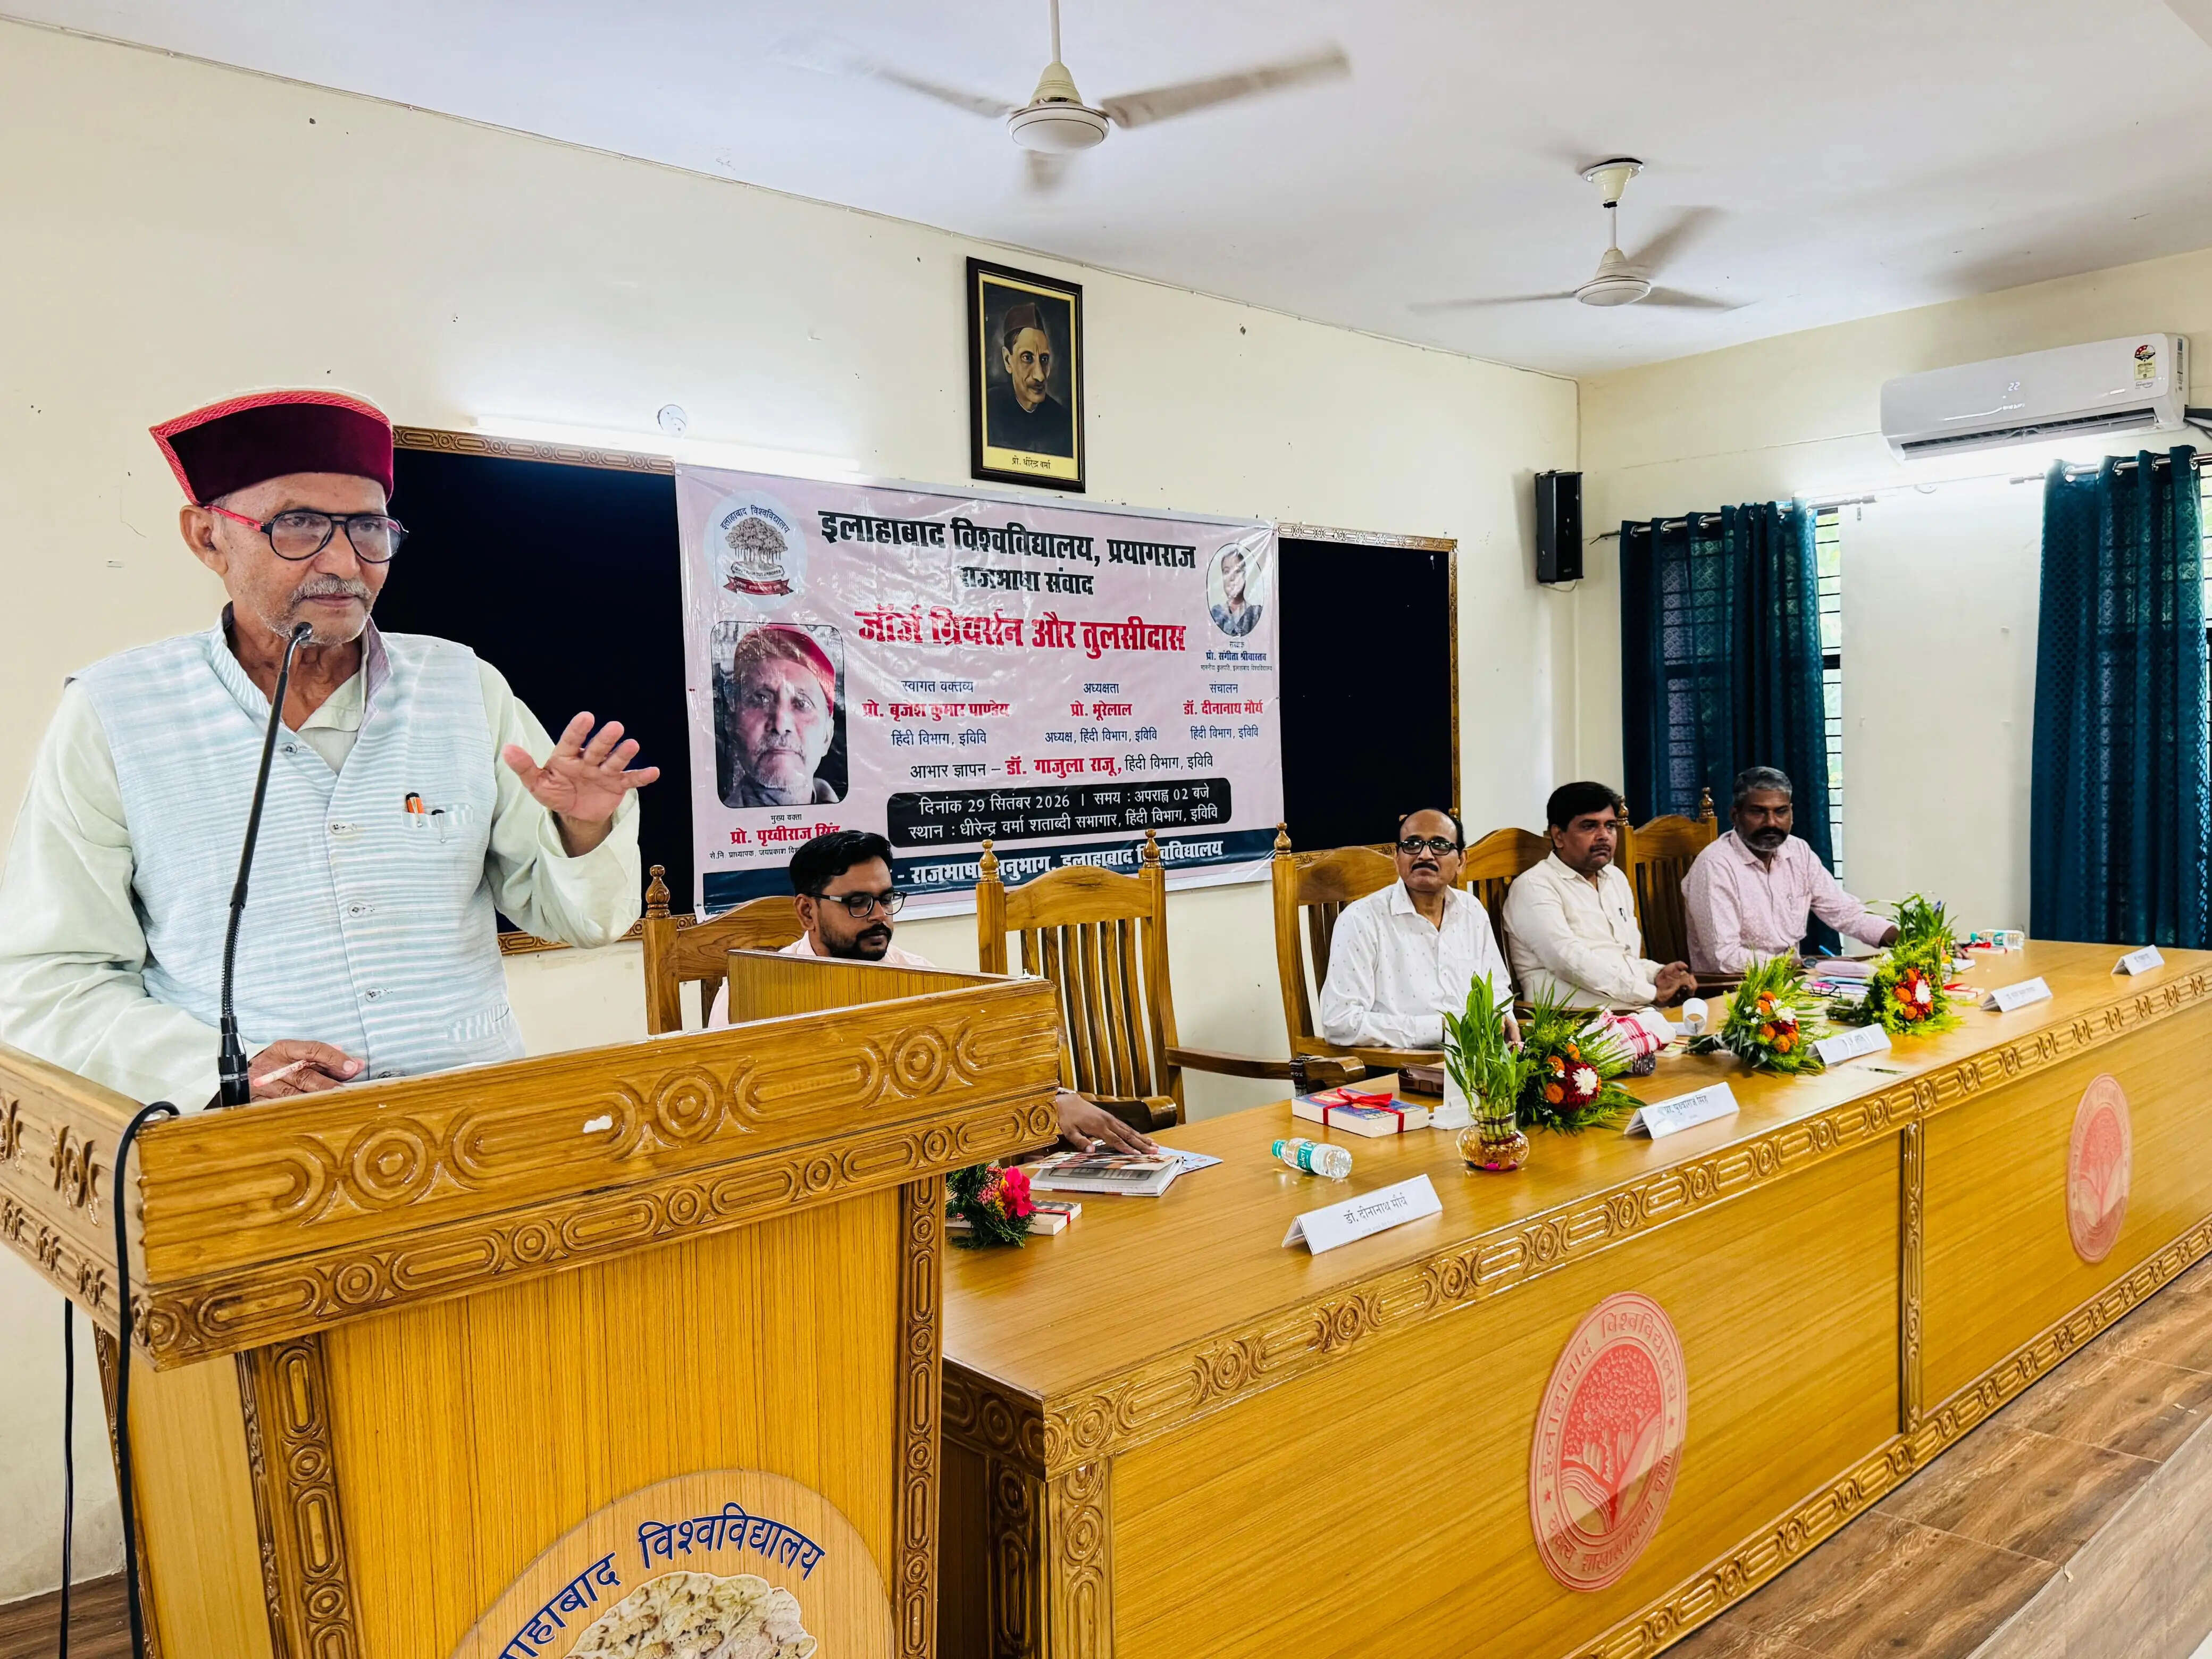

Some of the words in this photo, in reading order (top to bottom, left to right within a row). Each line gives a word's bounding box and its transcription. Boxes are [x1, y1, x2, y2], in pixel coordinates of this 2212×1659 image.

[1012, 455, 1021, 465] प्रो.
[1023, 457, 1038, 468] धीरेन्द्र
[1040, 459, 1051, 469] वर्मा
[720, 508, 747, 530] इलाहाबाद
[751, 505, 790, 533] विश्वविद्यालय
[818, 510, 945, 548] इलाहाबाद
[950, 516, 1100, 567] विश्वविद्यालय,
[1107, 538, 1196, 568] प्रयागराज
[961, 566, 1041, 592] राजभाषा
[1044, 567, 1094, 595] संवाद
[854, 604, 923, 643] जॉर्ज
[1032, 611, 1077, 648] और
[1080, 616, 1186, 660] तुलसीदास
[1205, 649, 1216, 661] प्रो.
[1218, 650, 1238, 661] संगीता
[1241, 650, 1267, 661] श्रीवास्तव
[901, 681, 935, 692] स्वागत
[940, 681, 973, 692] वक्तव्य
[1083, 683, 1119, 694] अध्यक्षता
[1209, 681, 1238, 693] संचालन
[861, 699, 884, 717] प्रो.
[889, 700, 926, 722] बृजेश
[929, 703, 966, 721] कुमार
[968, 700, 1010, 717] पाण्डेय
[1070, 700, 1088, 716] प्रो.
[1183, 700, 1197, 715] डॉ.
[1201, 700, 1242, 715] दीनानाथ
[1244, 699, 1263, 714] मौर्य
[891, 729, 914, 747] हिंदी
[918, 730, 954, 746] विभाग,
[958, 729, 986, 746] इविवि
[1045, 731, 1077, 744] अध्यक्ष,
[1080, 727, 1098, 743] हिंदी
[1102, 728, 1131, 742] विभाग,
[1135, 726, 1157, 742] इविवि
[1190, 726, 1206, 740] हिंदी
[1210, 725, 1235, 739] विभाग,
[1238, 724, 1259, 739] इविवि
[910, 765, 948, 778] आभार
[953, 764, 986, 777] ज्ञापन
[1005, 756, 1027, 775] डॉ.
[1034, 757, 1085, 778] गाजुला
[1089, 757, 1122, 777] राजू,
[1124, 755, 1145, 772] हिंदी
[1150, 753, 1183, 770] विभाग,
[1186, 752, 1213, 770] इविवि
[919, 796, 962, 815] दिनांक
[968, 799, 985, 812] 29
[990, 793, 1031, 811] सितंबर
[1036, 795, 1070, 809] 2026
[1093, 792, 1121, 805] समय
[1174, 789, 1188, 800] 02
[1192, 783, 1209, 799] बजे
[770, 815, 785, 824] मुख्य
[908, 825, 943, 840] स्थान
[960, 818, 996, 836] धीरेन्द्र
[1002, 815, 1024, 833] वर्मा
[1028, 812, 1070, 832] शताब्दी
[1075, 814, 1121, 828] सभागार,
[1125, 809, 1147, 825] हिंदी
[1151, 807, 1186, 823] विभाग,
[1190, 803, 1218, 822] इविवि
[730, 827, 752, 844] प्रो.
[757, 825, 812, 847] पृथ्वीराज
[1344, 1209, 1359, 1224] डॉ.
[1357, 1205, 1391, 1221] दीनानाथ
[1602, 1312, 1677, 1402] विश्वविद्यालय
[638, 1502, 826, 1581] विश्वविद्यालय
